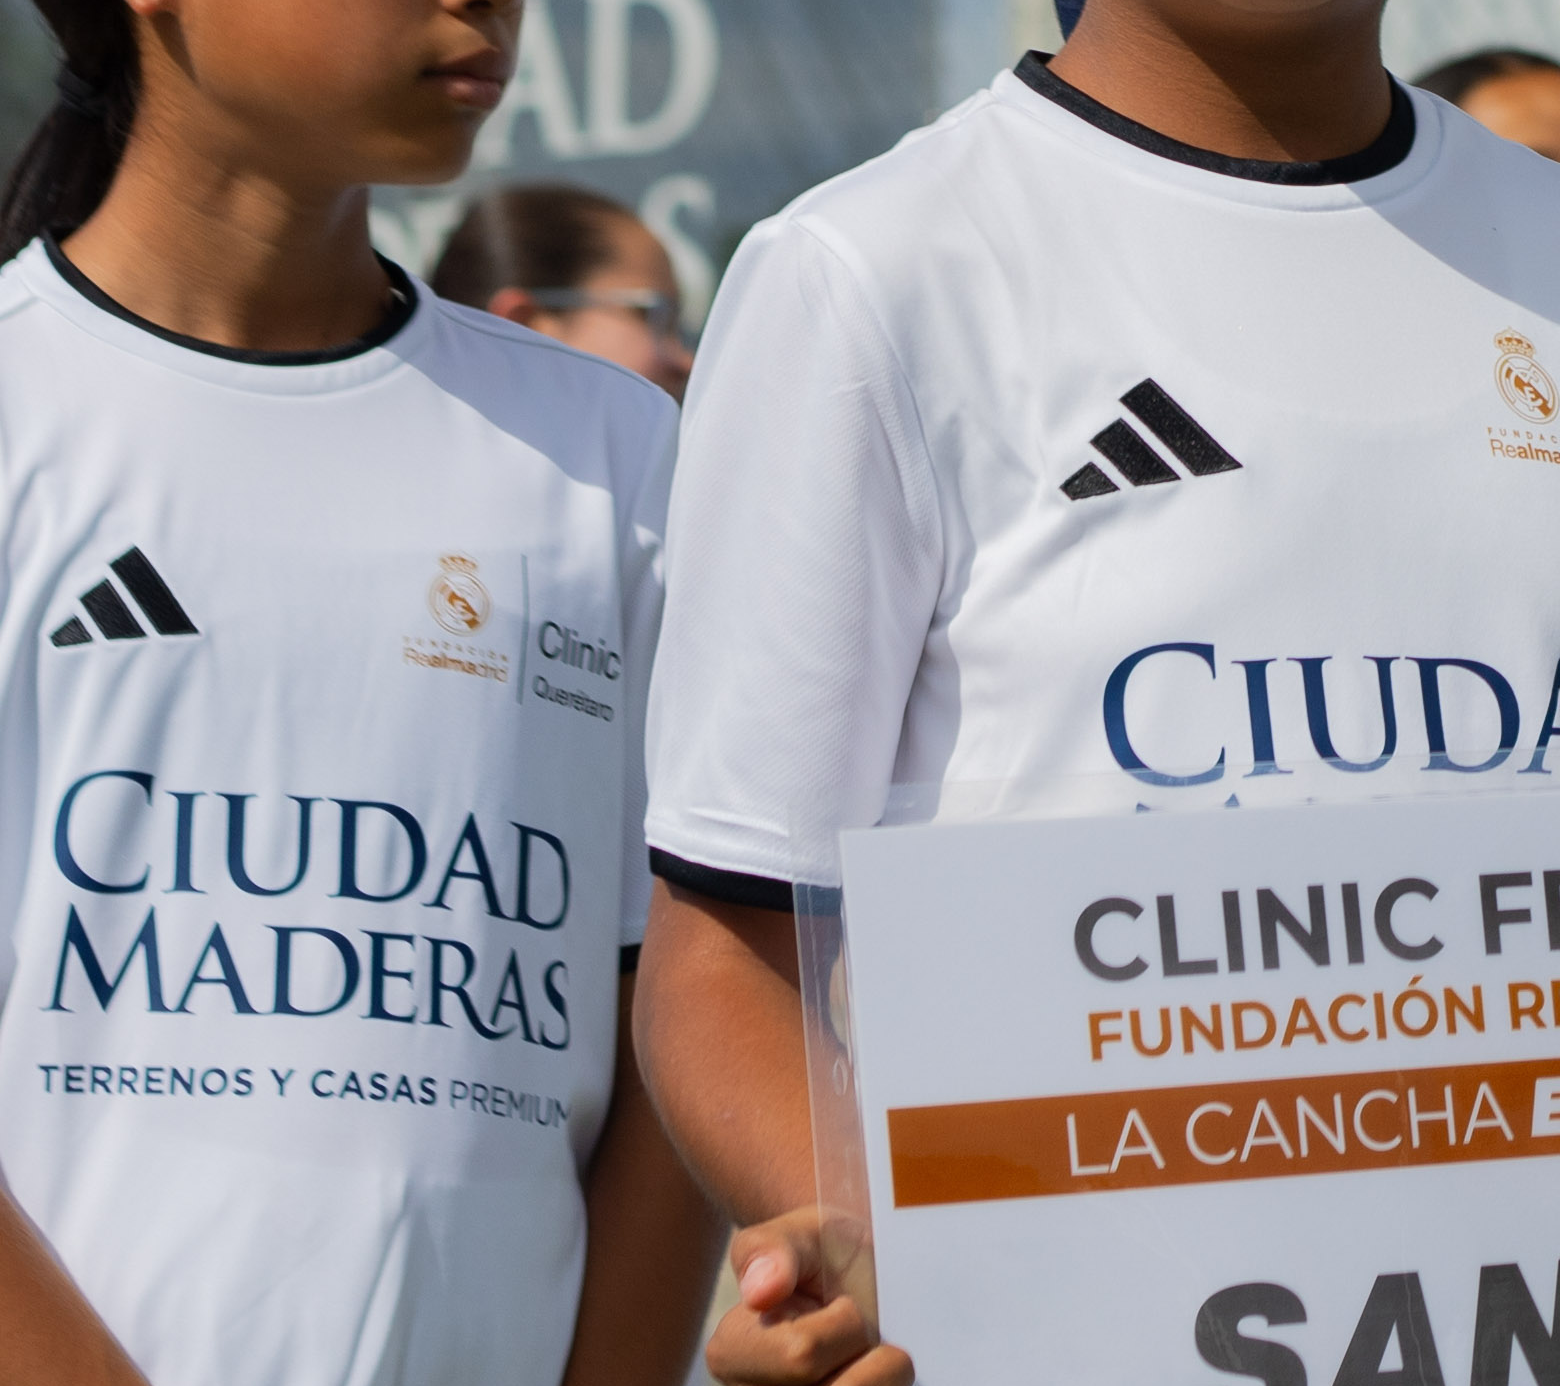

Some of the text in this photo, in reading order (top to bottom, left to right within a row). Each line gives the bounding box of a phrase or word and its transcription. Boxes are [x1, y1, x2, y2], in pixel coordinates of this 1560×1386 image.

[538, 620, 622, 681] Clinic
[53, 769, 572, 931] CIUDAD
[39, 902, 571, 1051] MADERAS
[1073, 876, 1445, 983] CLINIC
[1086, 975, 1485, 1063] FUNDACIÓN
[37, 1064, 253, 1096] TERRENOS
[269, 1068, 296, 1097] Y
[311, 1068, 437, 1106] CASAS
[1064, 1105, 1166, 1178] LA
[1183, 1078, 1515, 1166] CANCHA
